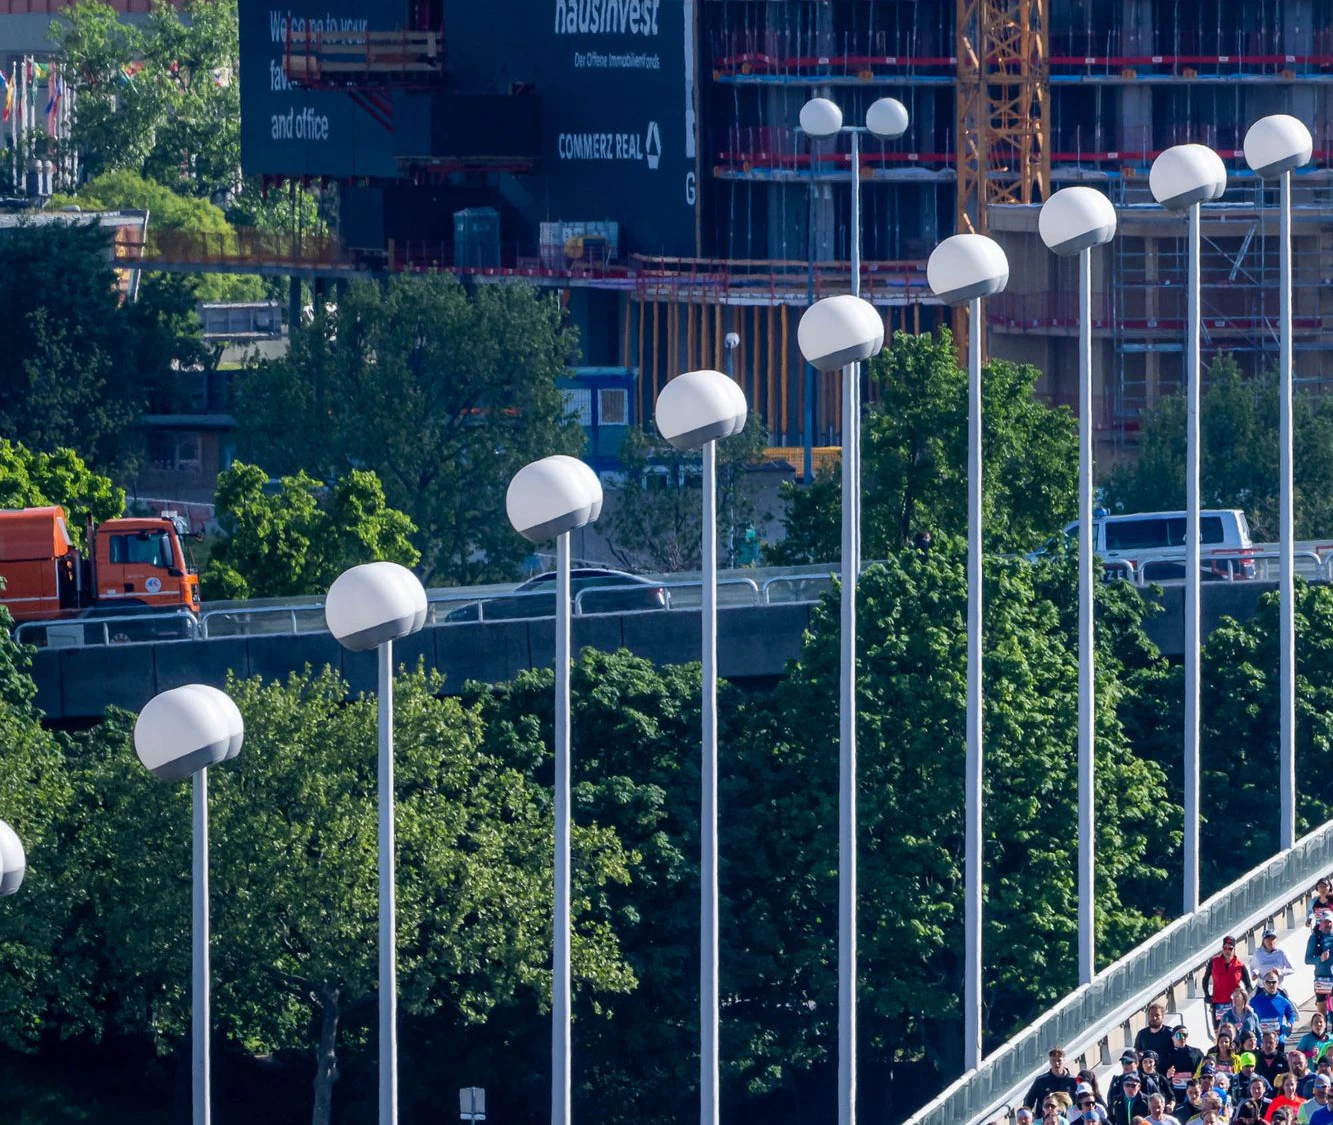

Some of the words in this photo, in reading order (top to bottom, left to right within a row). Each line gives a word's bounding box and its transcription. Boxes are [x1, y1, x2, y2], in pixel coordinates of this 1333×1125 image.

[574, 52, 586, 67] Der
[587, 51, 608, 68] Offene
[609, 52, 660, 70] Immobilienfonds
[271, 107, 293, 140] and
[295, 107, 329, 140] office
[558, 132, 614, 160] COMMERZ
[615, 133, 644, 160] REAL
